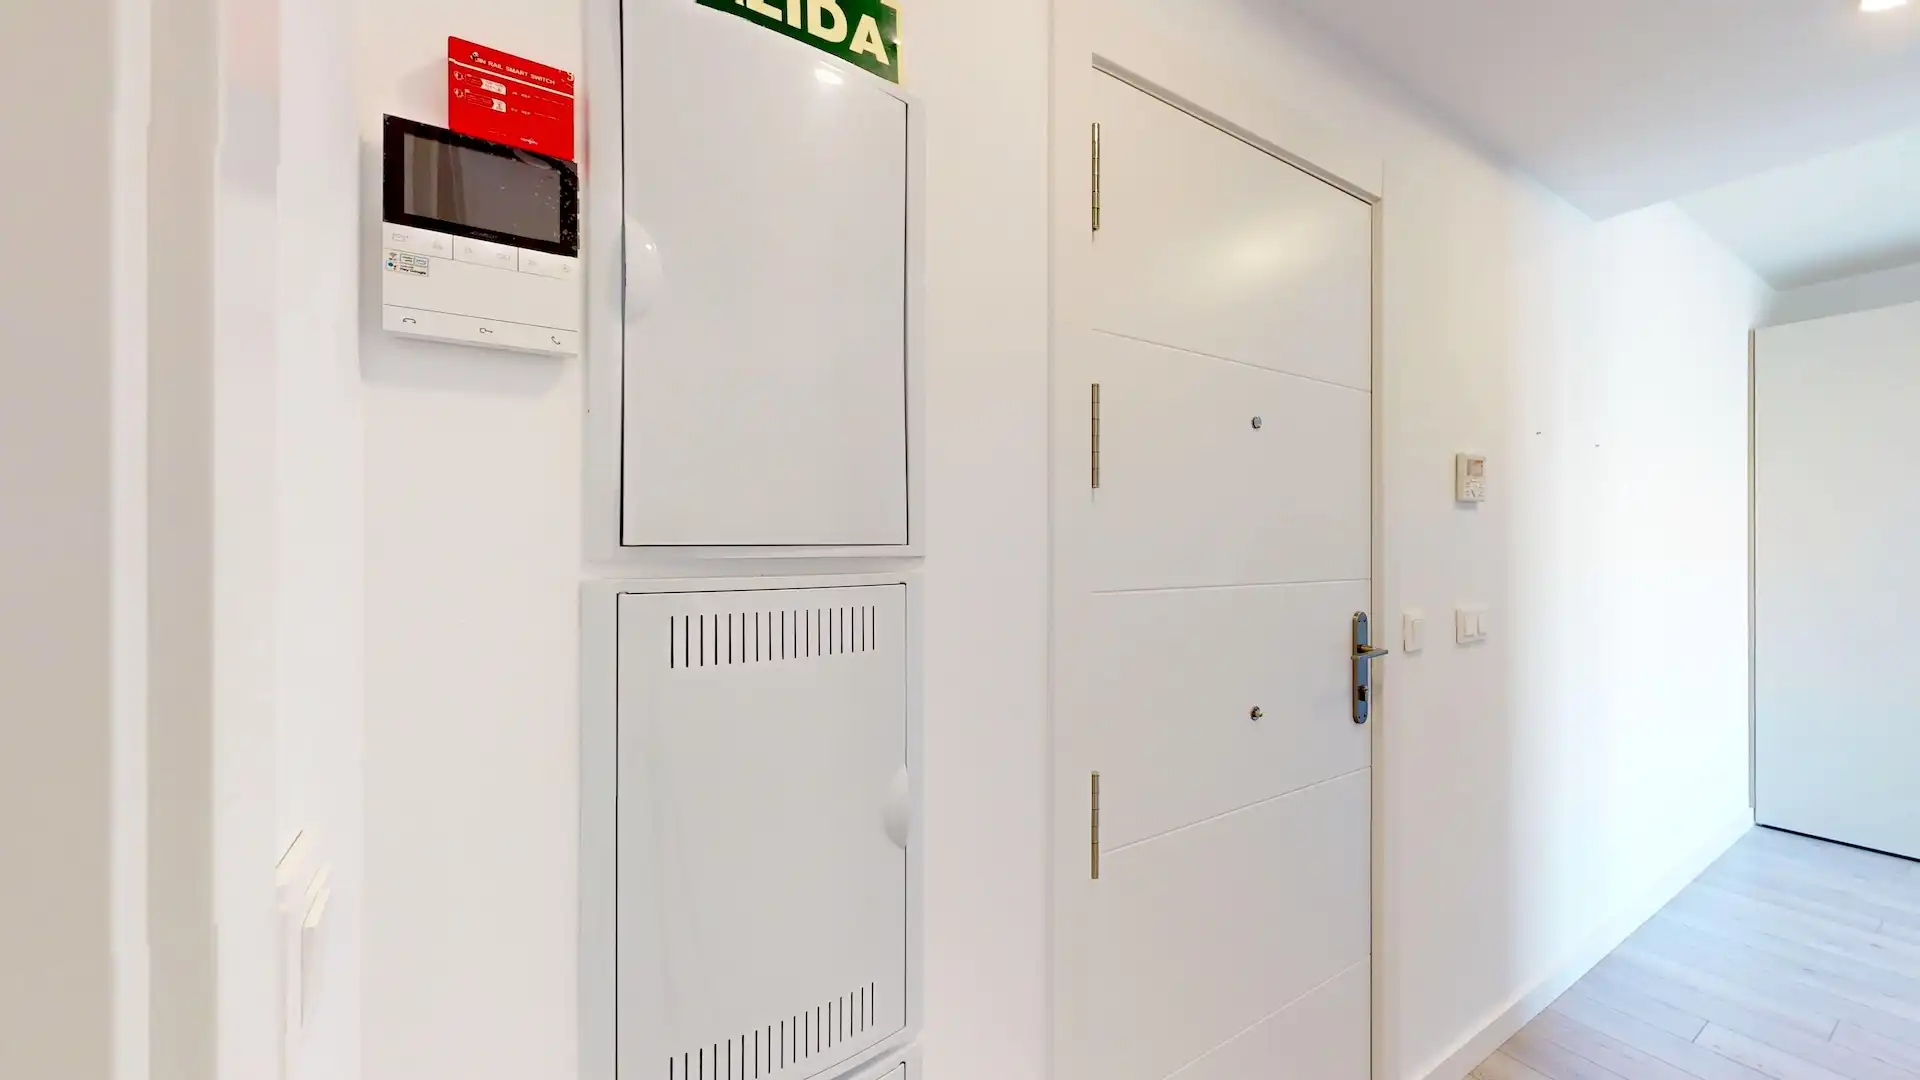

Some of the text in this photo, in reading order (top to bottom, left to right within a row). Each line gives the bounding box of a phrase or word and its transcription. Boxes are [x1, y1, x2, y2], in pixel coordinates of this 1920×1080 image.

[488, 60, 503, 70] RAIL
[505, 66, 529, 77] SMART
[530, 73, 556, 85] SWITCH
